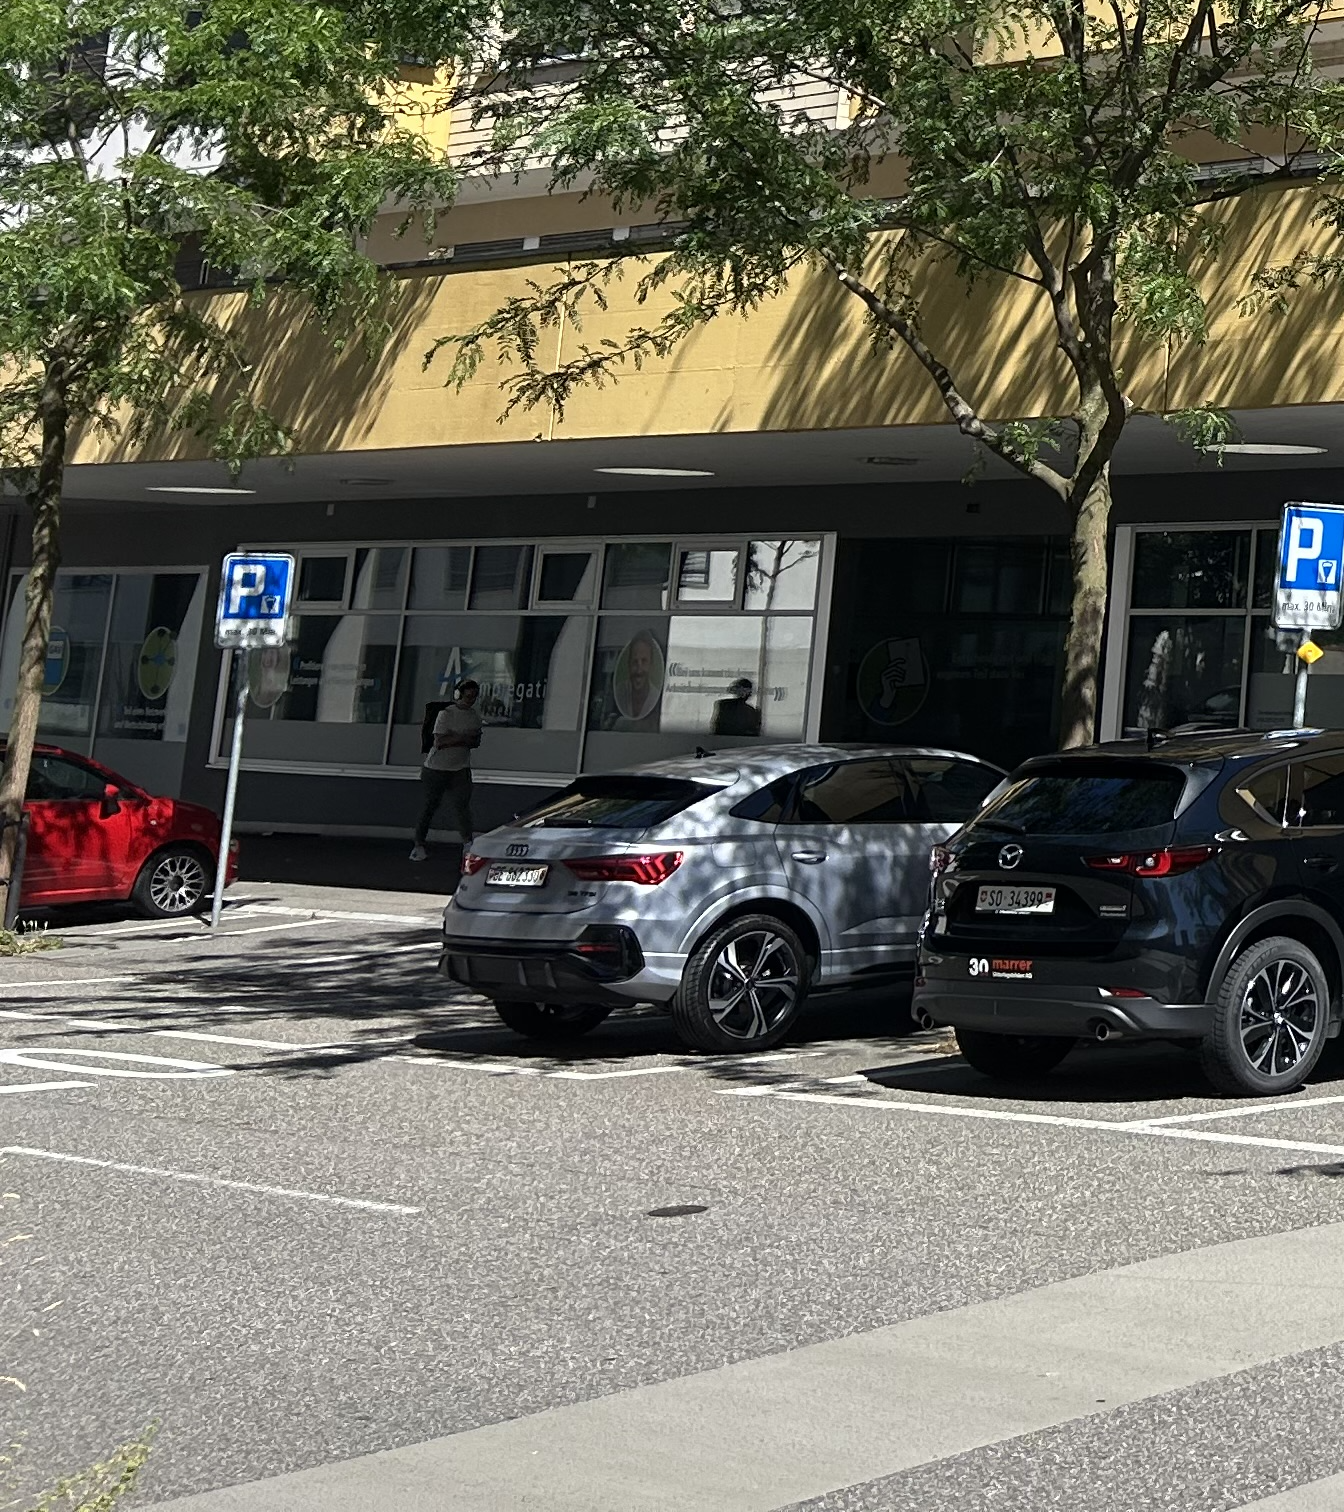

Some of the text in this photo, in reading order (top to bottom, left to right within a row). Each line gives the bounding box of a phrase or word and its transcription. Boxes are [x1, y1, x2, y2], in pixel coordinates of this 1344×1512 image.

[1286, 516, 1324, 582] P
[228, 564, 267, 614] P
[1303, 601, 1315, 611] 30
[992, 958, 1034, 971] marrer
